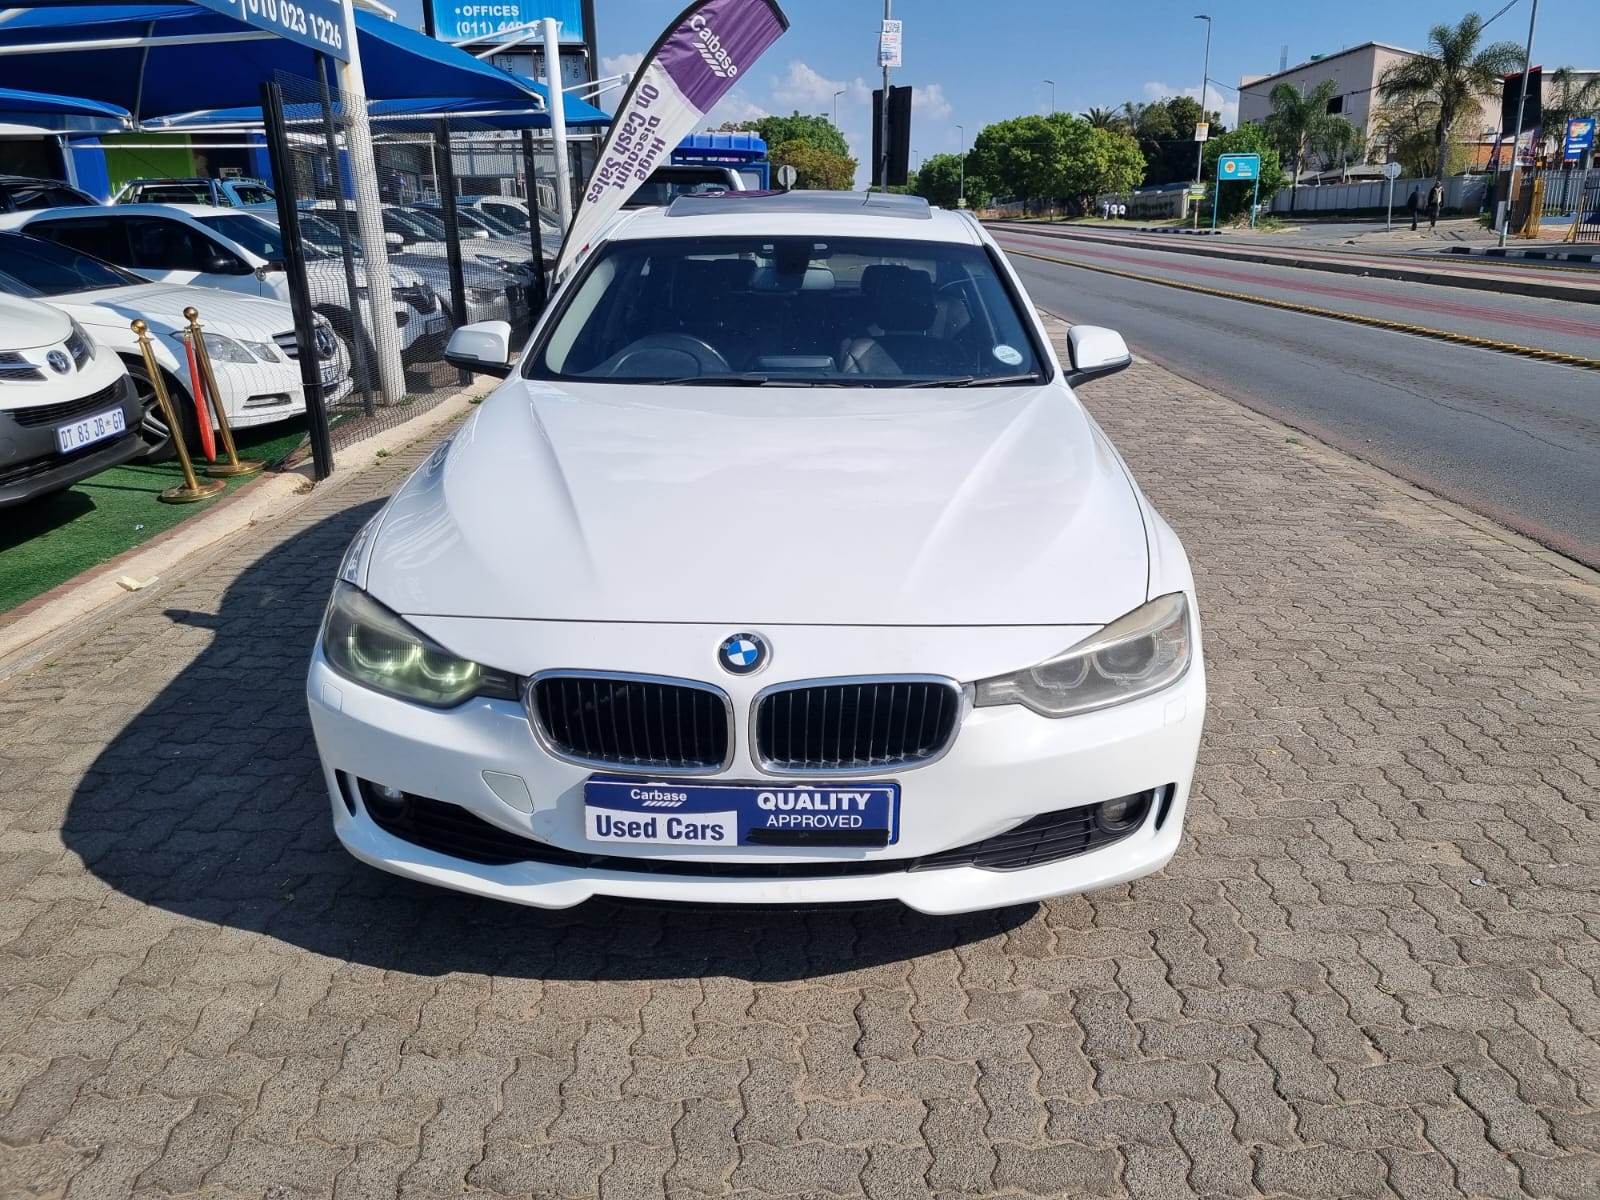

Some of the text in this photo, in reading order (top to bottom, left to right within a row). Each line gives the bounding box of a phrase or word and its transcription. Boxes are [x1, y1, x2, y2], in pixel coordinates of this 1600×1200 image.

[280, 0, 307, 35] 023
[309, 13, 342, 50] 1226
[462, 5, 520, 17] OFFICES
[456, 21, 494, 36] (011)
[690, 14, 738, 78] Carbase
[586, 83, 659, 204] On Cash Sales
[611, 115, 661, 190] Discount
[634, 136, 666, 181] Huge
[61, 411, 124, 449] DT 83 JB GP
[630, 788, 688, 801] Carbase
[757, 792, 872, 811] QUALITY
[596, 814, 725, 842] Used Cars
[766, 814, 863, 828] APPROVED
